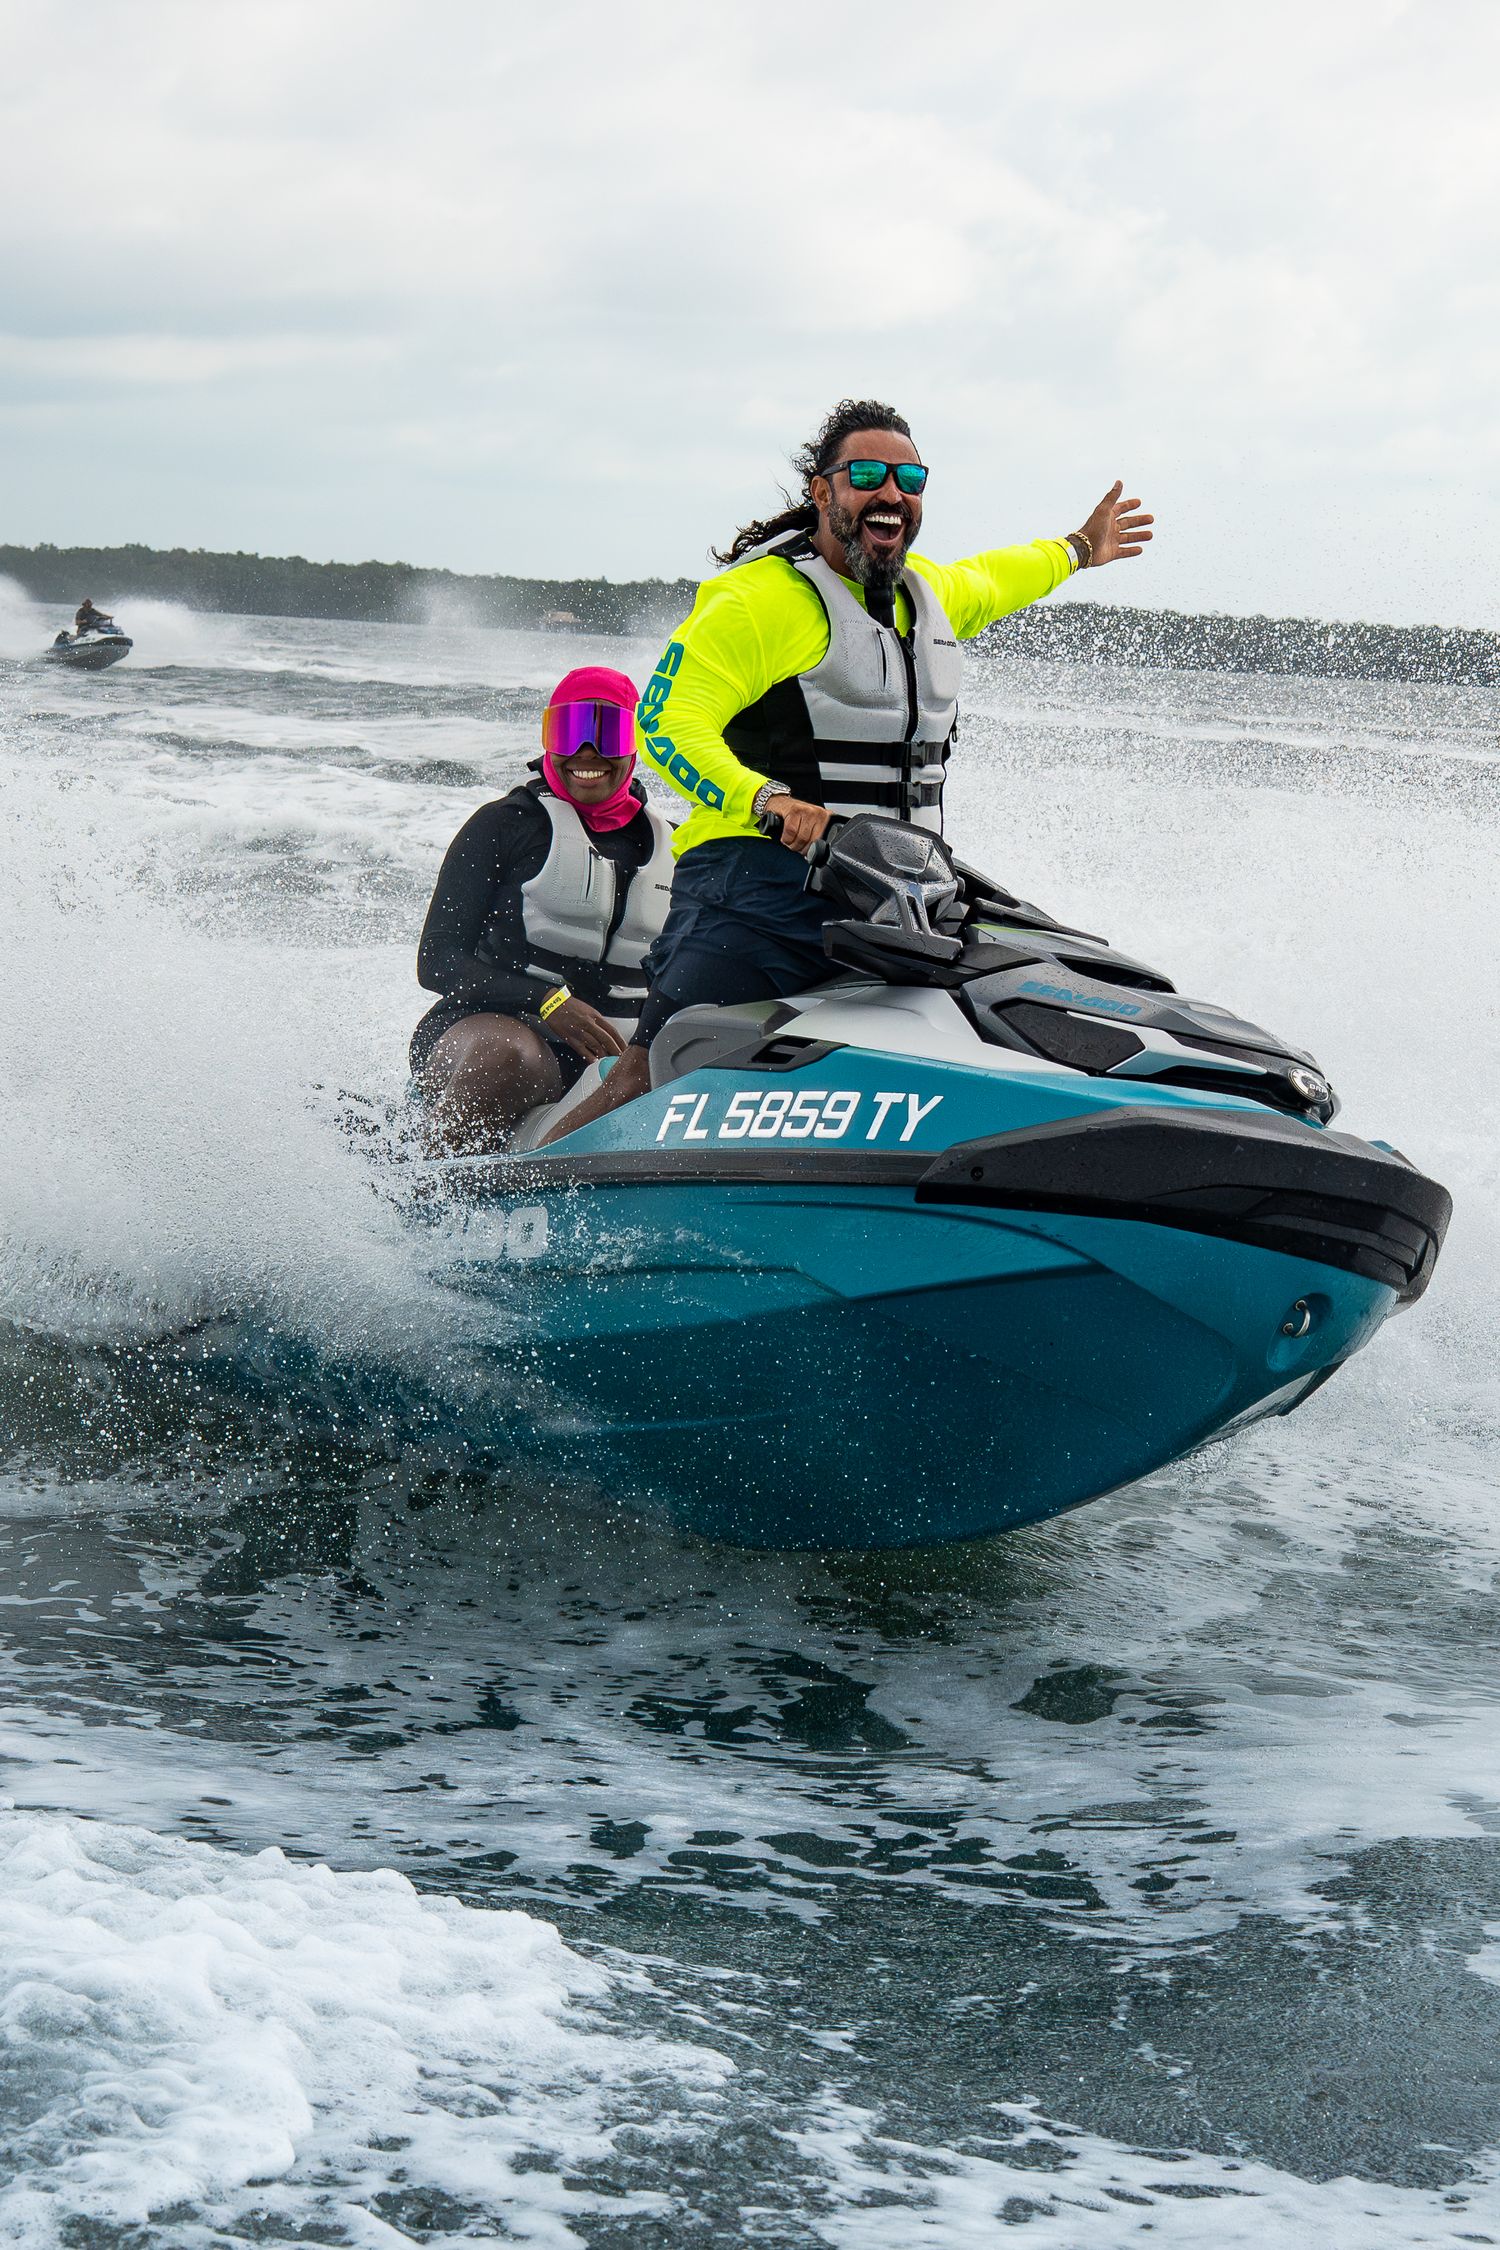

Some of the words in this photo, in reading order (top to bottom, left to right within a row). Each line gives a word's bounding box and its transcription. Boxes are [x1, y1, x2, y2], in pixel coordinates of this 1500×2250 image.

[655, 1093, 709, 1142] FL
[718, 1091, 861, 1139] 5859
[865, 1092, 944, 1141] TY
